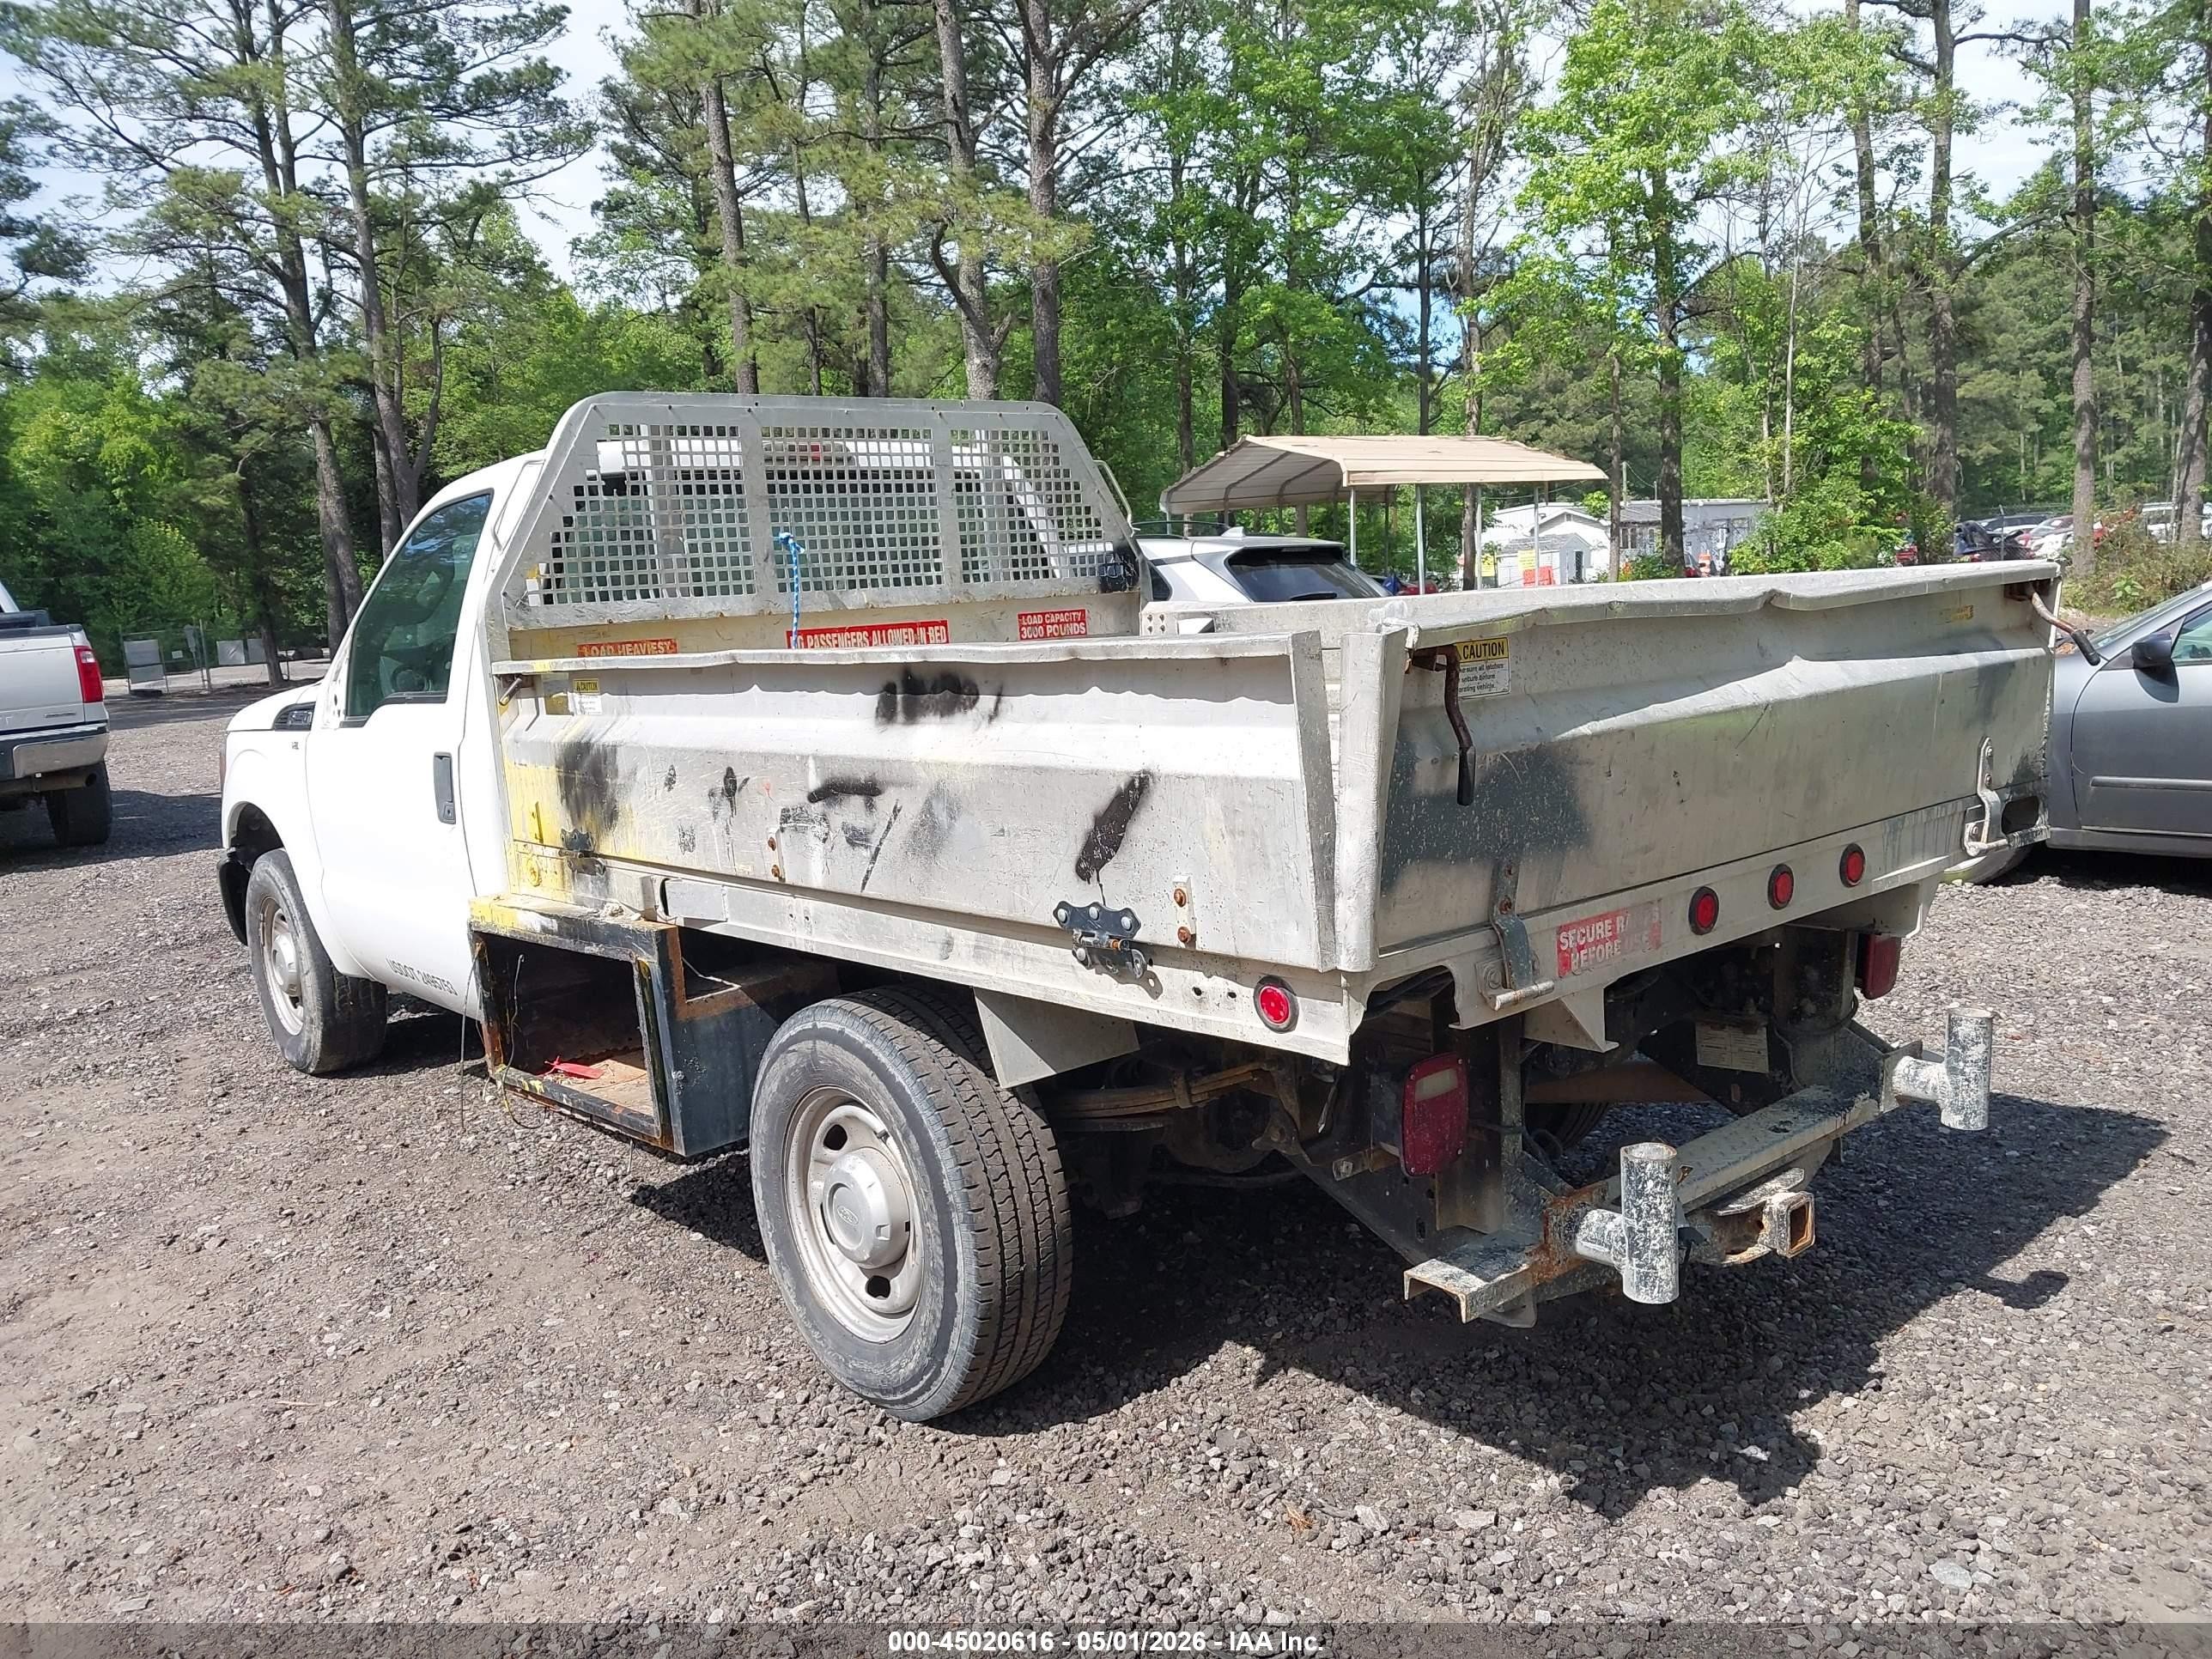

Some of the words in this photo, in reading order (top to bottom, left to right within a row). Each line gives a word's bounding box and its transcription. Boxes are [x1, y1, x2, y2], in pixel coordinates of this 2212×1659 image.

[1022, 613, 1043, 625] LOAD
[1044, 611, 1081, 623] CAPACITY
[807, 630, 870, 649] PASSENGERS
[872, 628, 915, 647] ALLOWED
[916, 626, 926, 645] IN
[928, 624, 947, 644] BED
[1021, 626, 1044, 639] 3000
[1047, 623, 1086, 637] POUNDS
[617, 640, 673, 656] HEAVIEST
[1462, 641, 1504, 659] CAUTION
[1559, 920, 1613, 951] SECURE
[1571, 939, 1621, 969] BEFORE
[386, 957, 420, 982] USDOT
